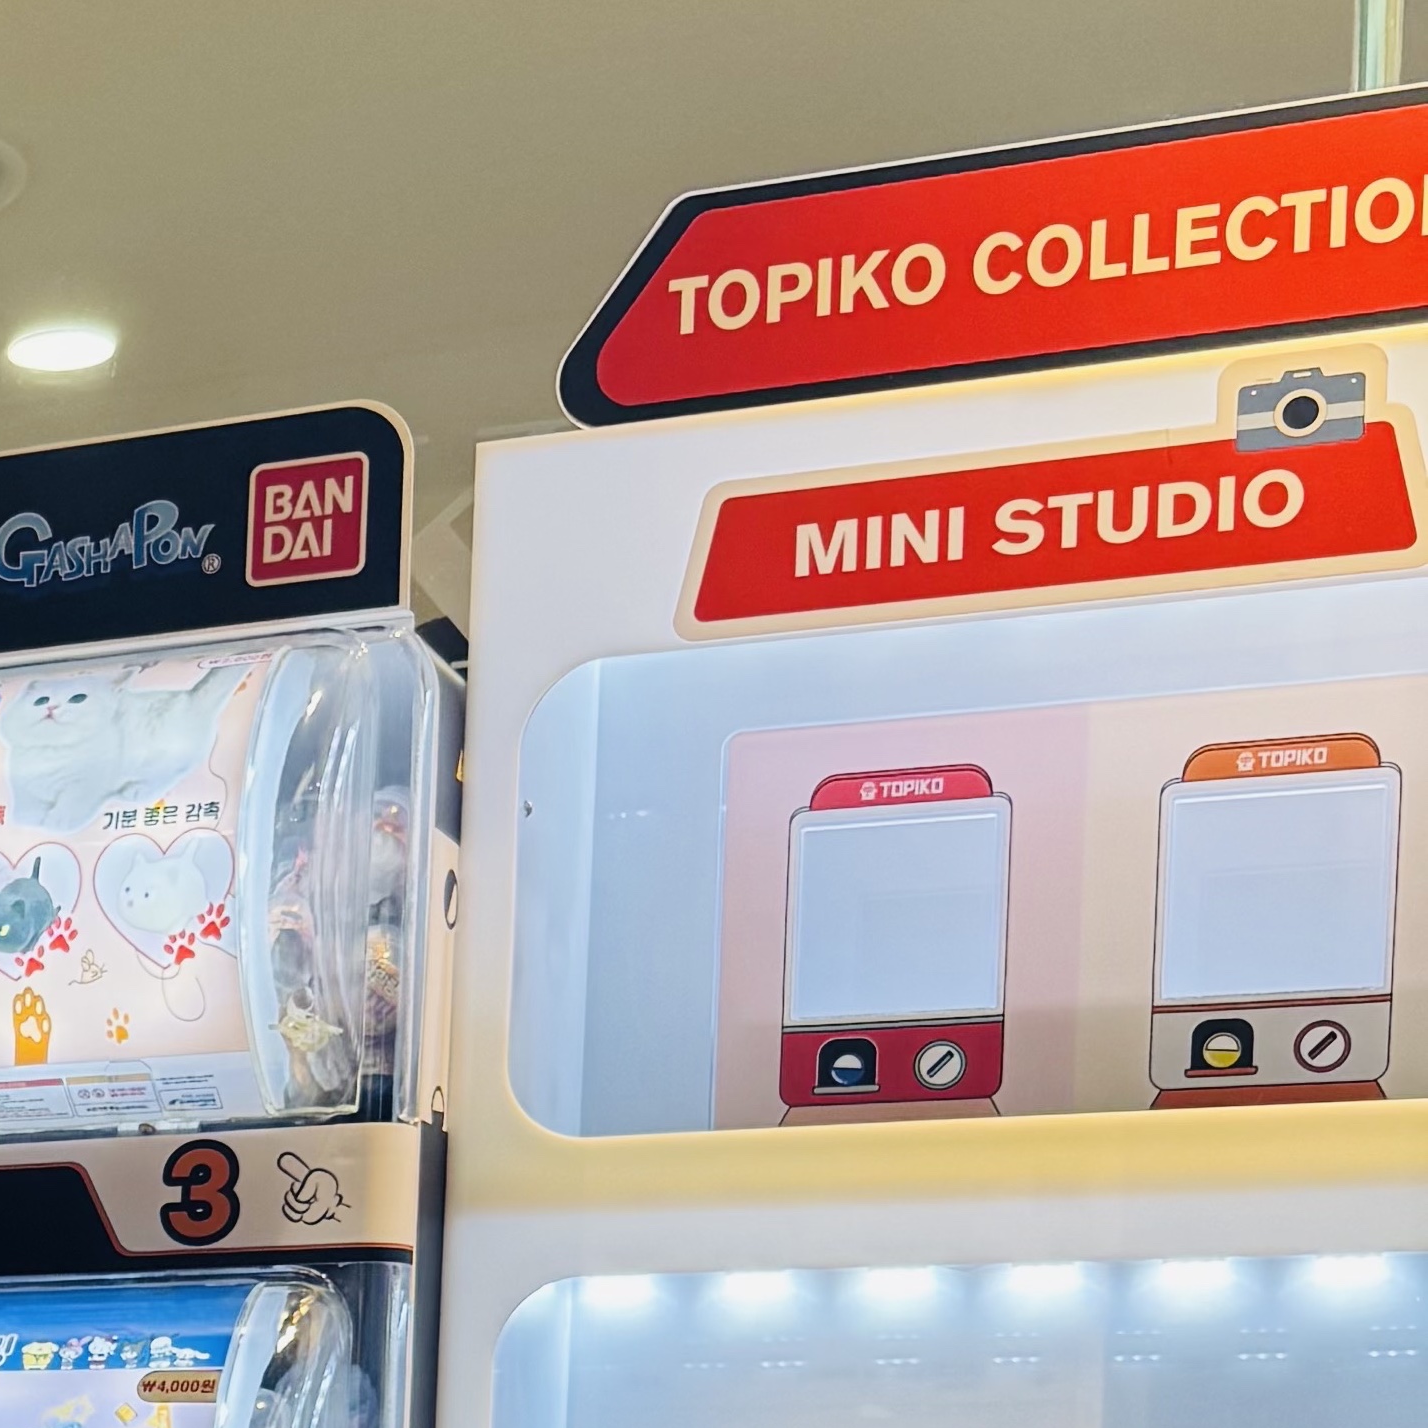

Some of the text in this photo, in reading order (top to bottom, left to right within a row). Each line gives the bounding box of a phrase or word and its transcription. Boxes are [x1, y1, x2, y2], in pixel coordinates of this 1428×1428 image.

[668, 177, 1428, 334] TOPIKO COLLECTIO
[264, 475, 353, 523] BAN
[262, 519, 333, 565] DAI
[793, 468, 1305, 578] MINI STUDIO
[1258, 747, 1327, 768] TOPIKO
[879, 777, 944, 798] TOPIKO
[103, 801, 221, 831] 기분 좋은 감촉
[160, 1139, 240, 1246] 3
[141, 1379, 216, 1394] ₩4,000원
